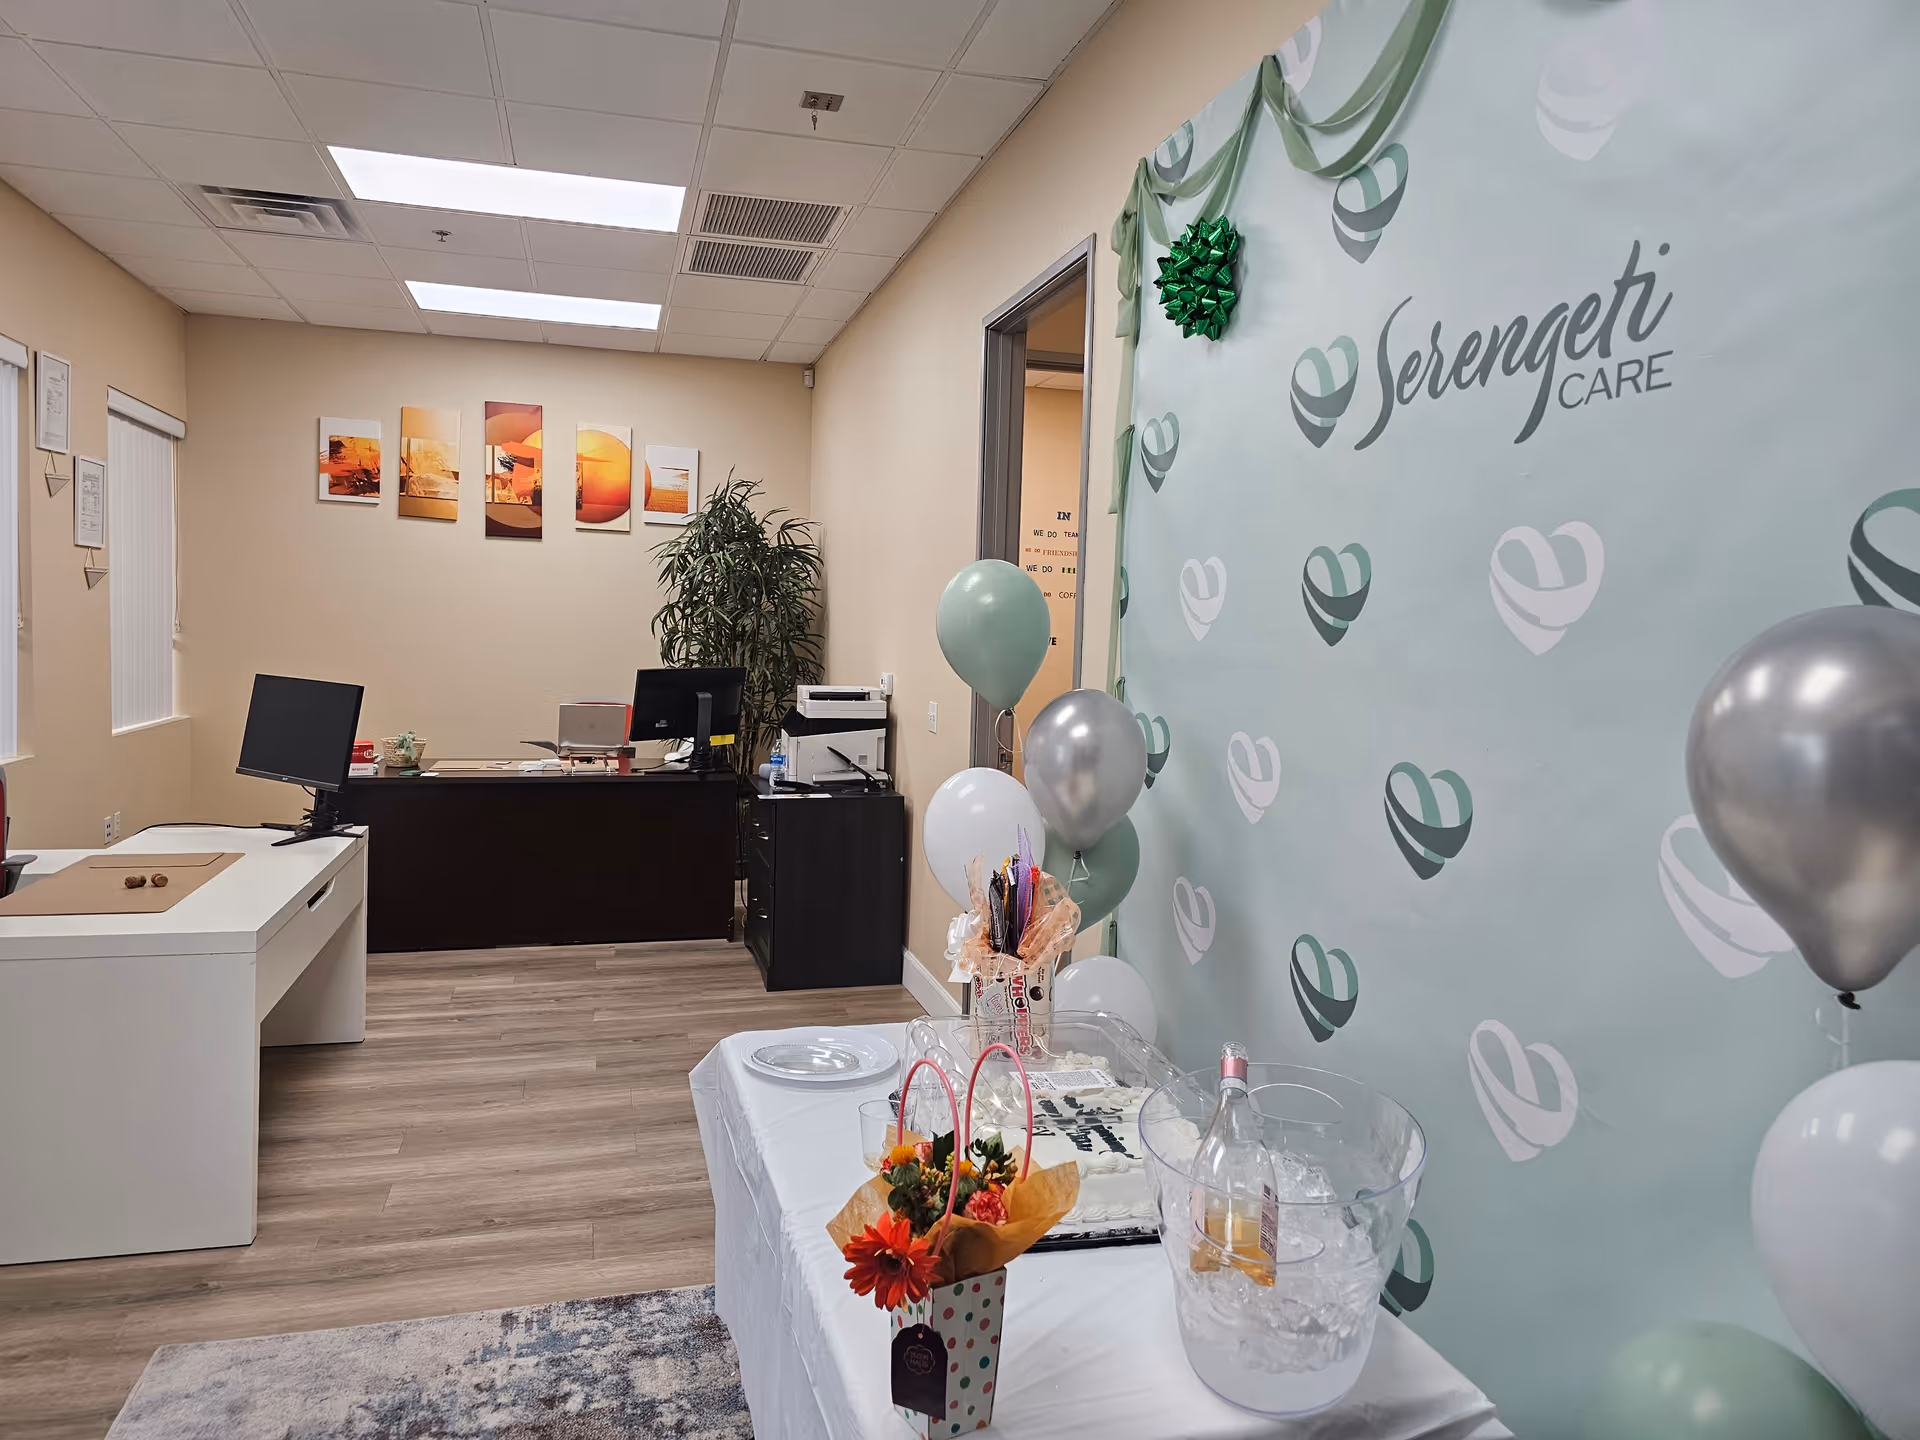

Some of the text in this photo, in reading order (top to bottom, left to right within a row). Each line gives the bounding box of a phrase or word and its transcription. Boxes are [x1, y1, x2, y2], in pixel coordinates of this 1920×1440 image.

[1354, 240, 1673, 450] Serengeti
[1558, 350, 1673, 409] CARE
[1057, 511, 1071, 521] IN
[1033, 529, 1044, 537] WE
[1047, 530, 1057, 538] DO
[1026, 564, 1037, 572] WE
[1042, 565, 1052, 573] DO
